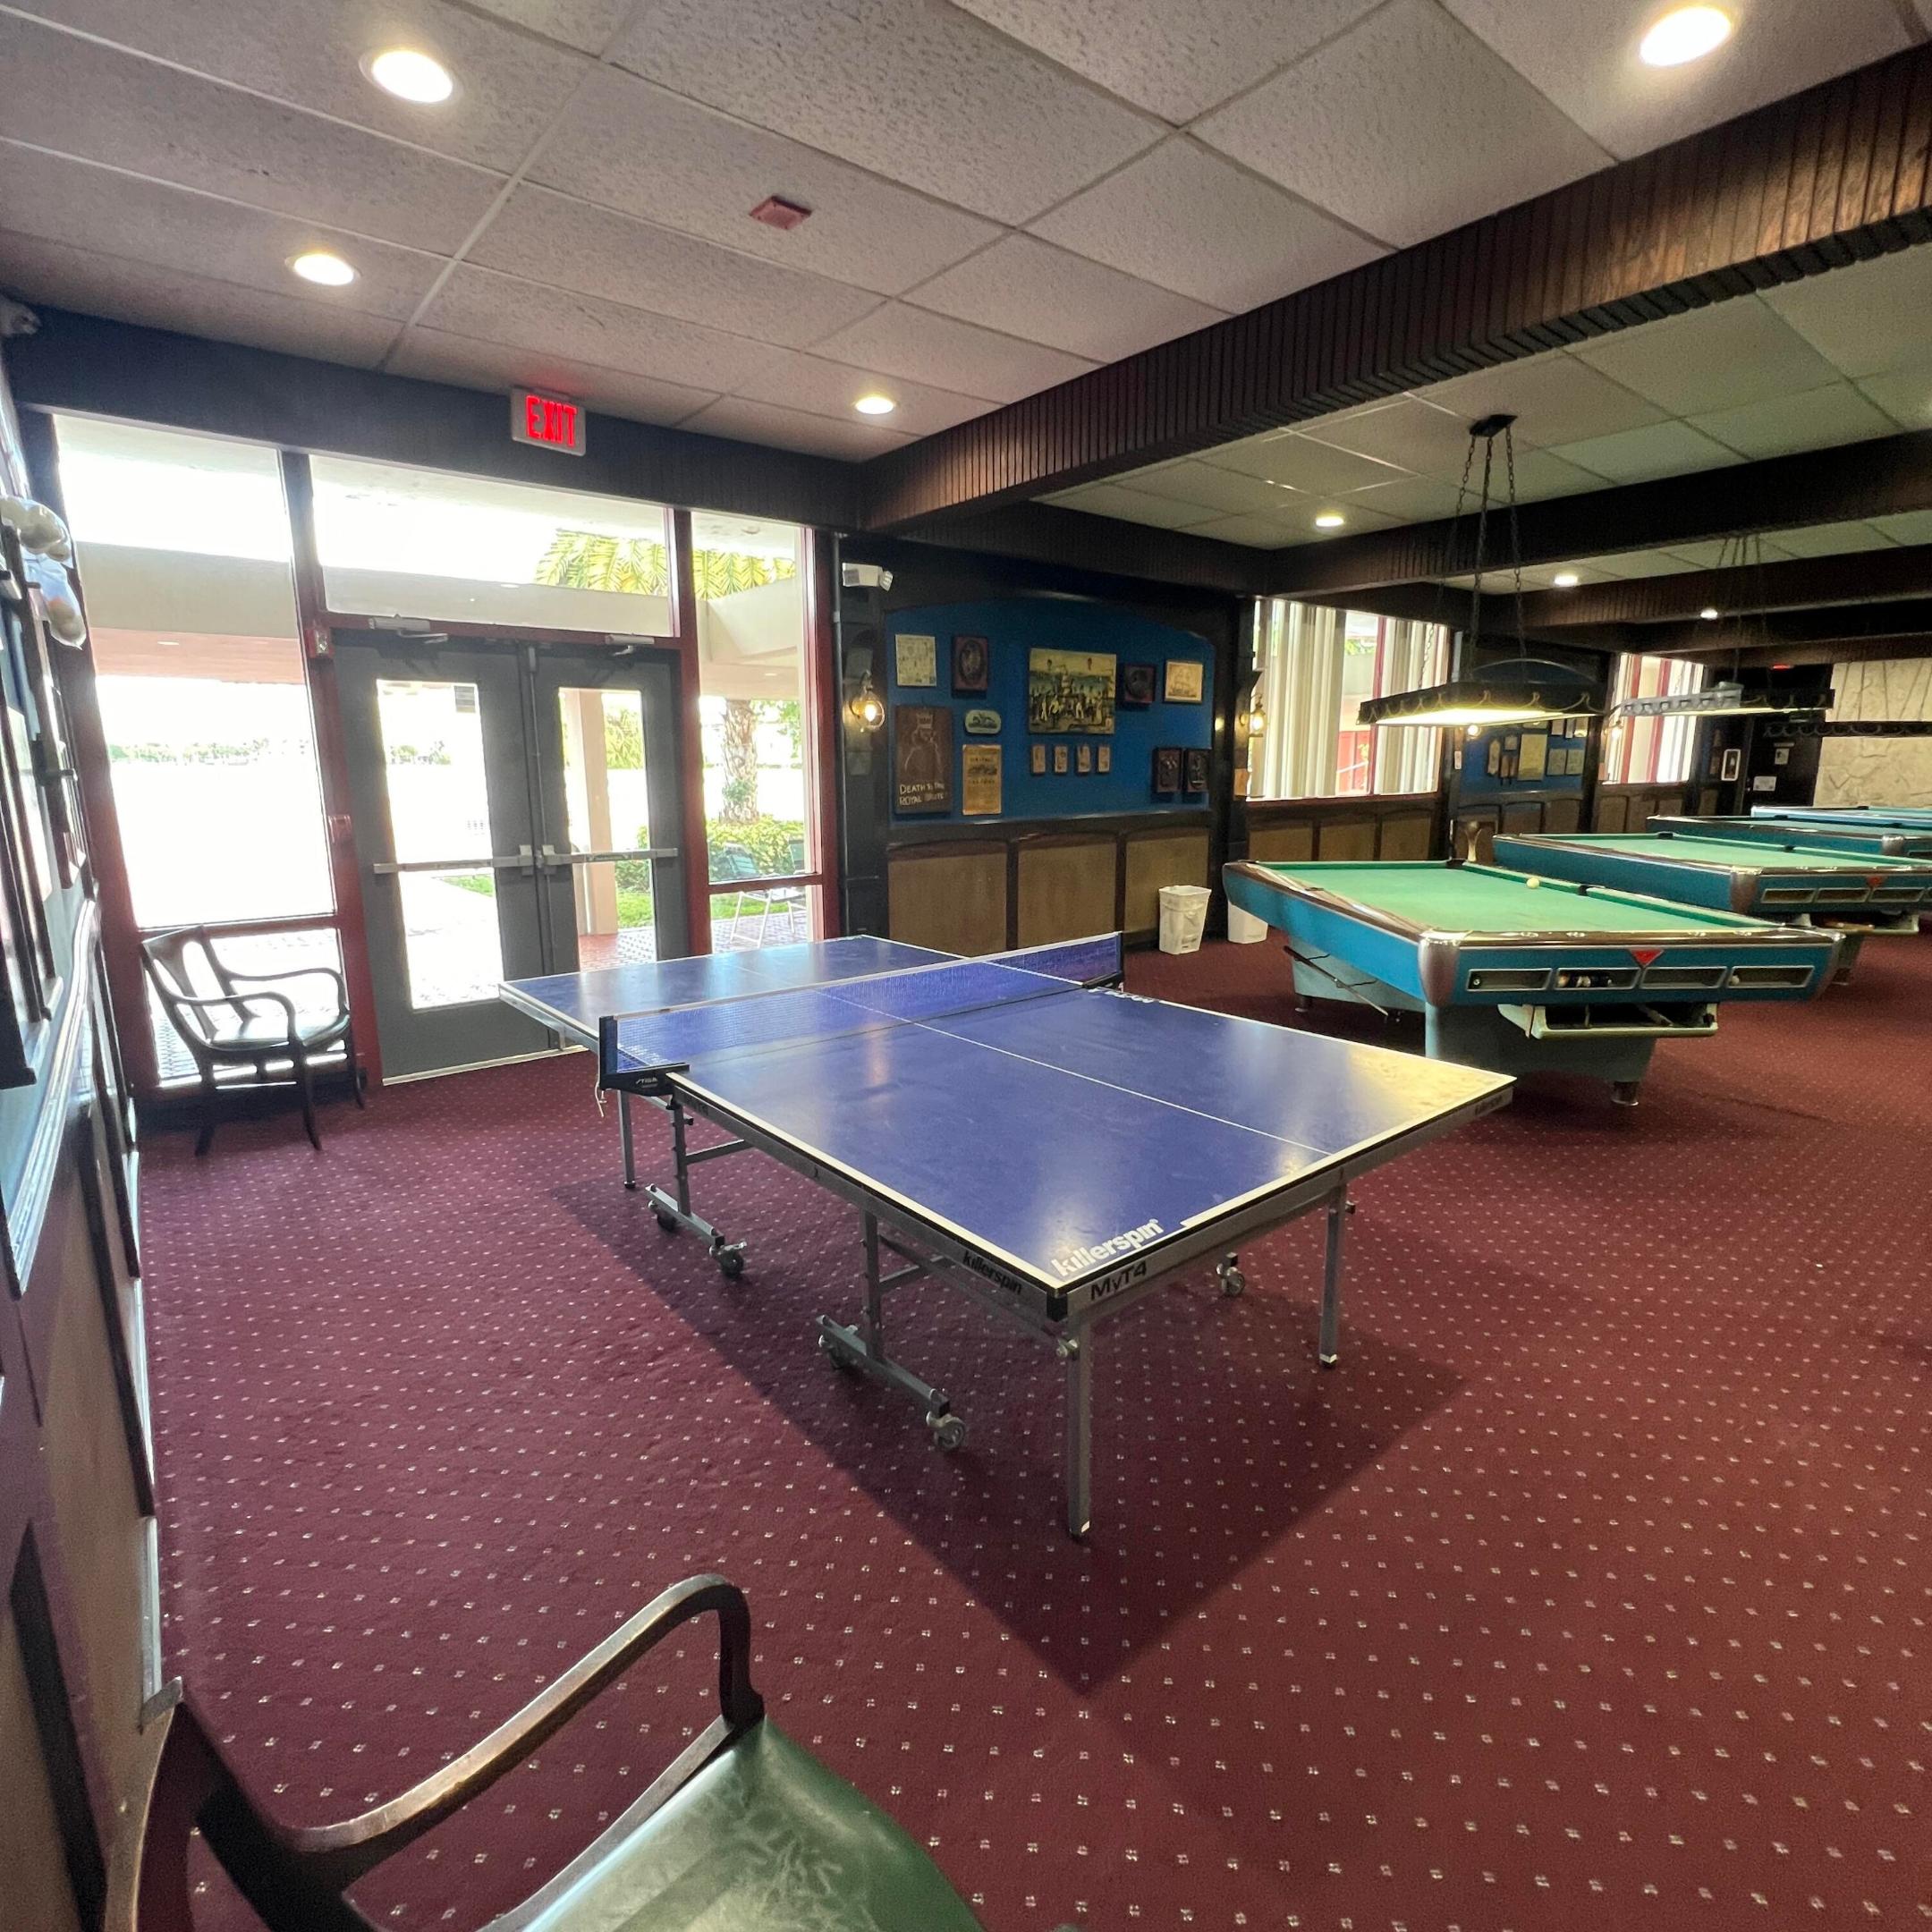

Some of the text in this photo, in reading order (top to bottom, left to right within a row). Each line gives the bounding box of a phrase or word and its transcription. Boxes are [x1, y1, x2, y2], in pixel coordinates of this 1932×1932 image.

[526, 394, 578, 448] EXIT
[899, 784, 926, 795] DEATH
[899, 795, 922, 806] ROYAL
[1051, 1221, 1164, 1277] killerspin
[962, 1250, 1022, 1295] killerspin
